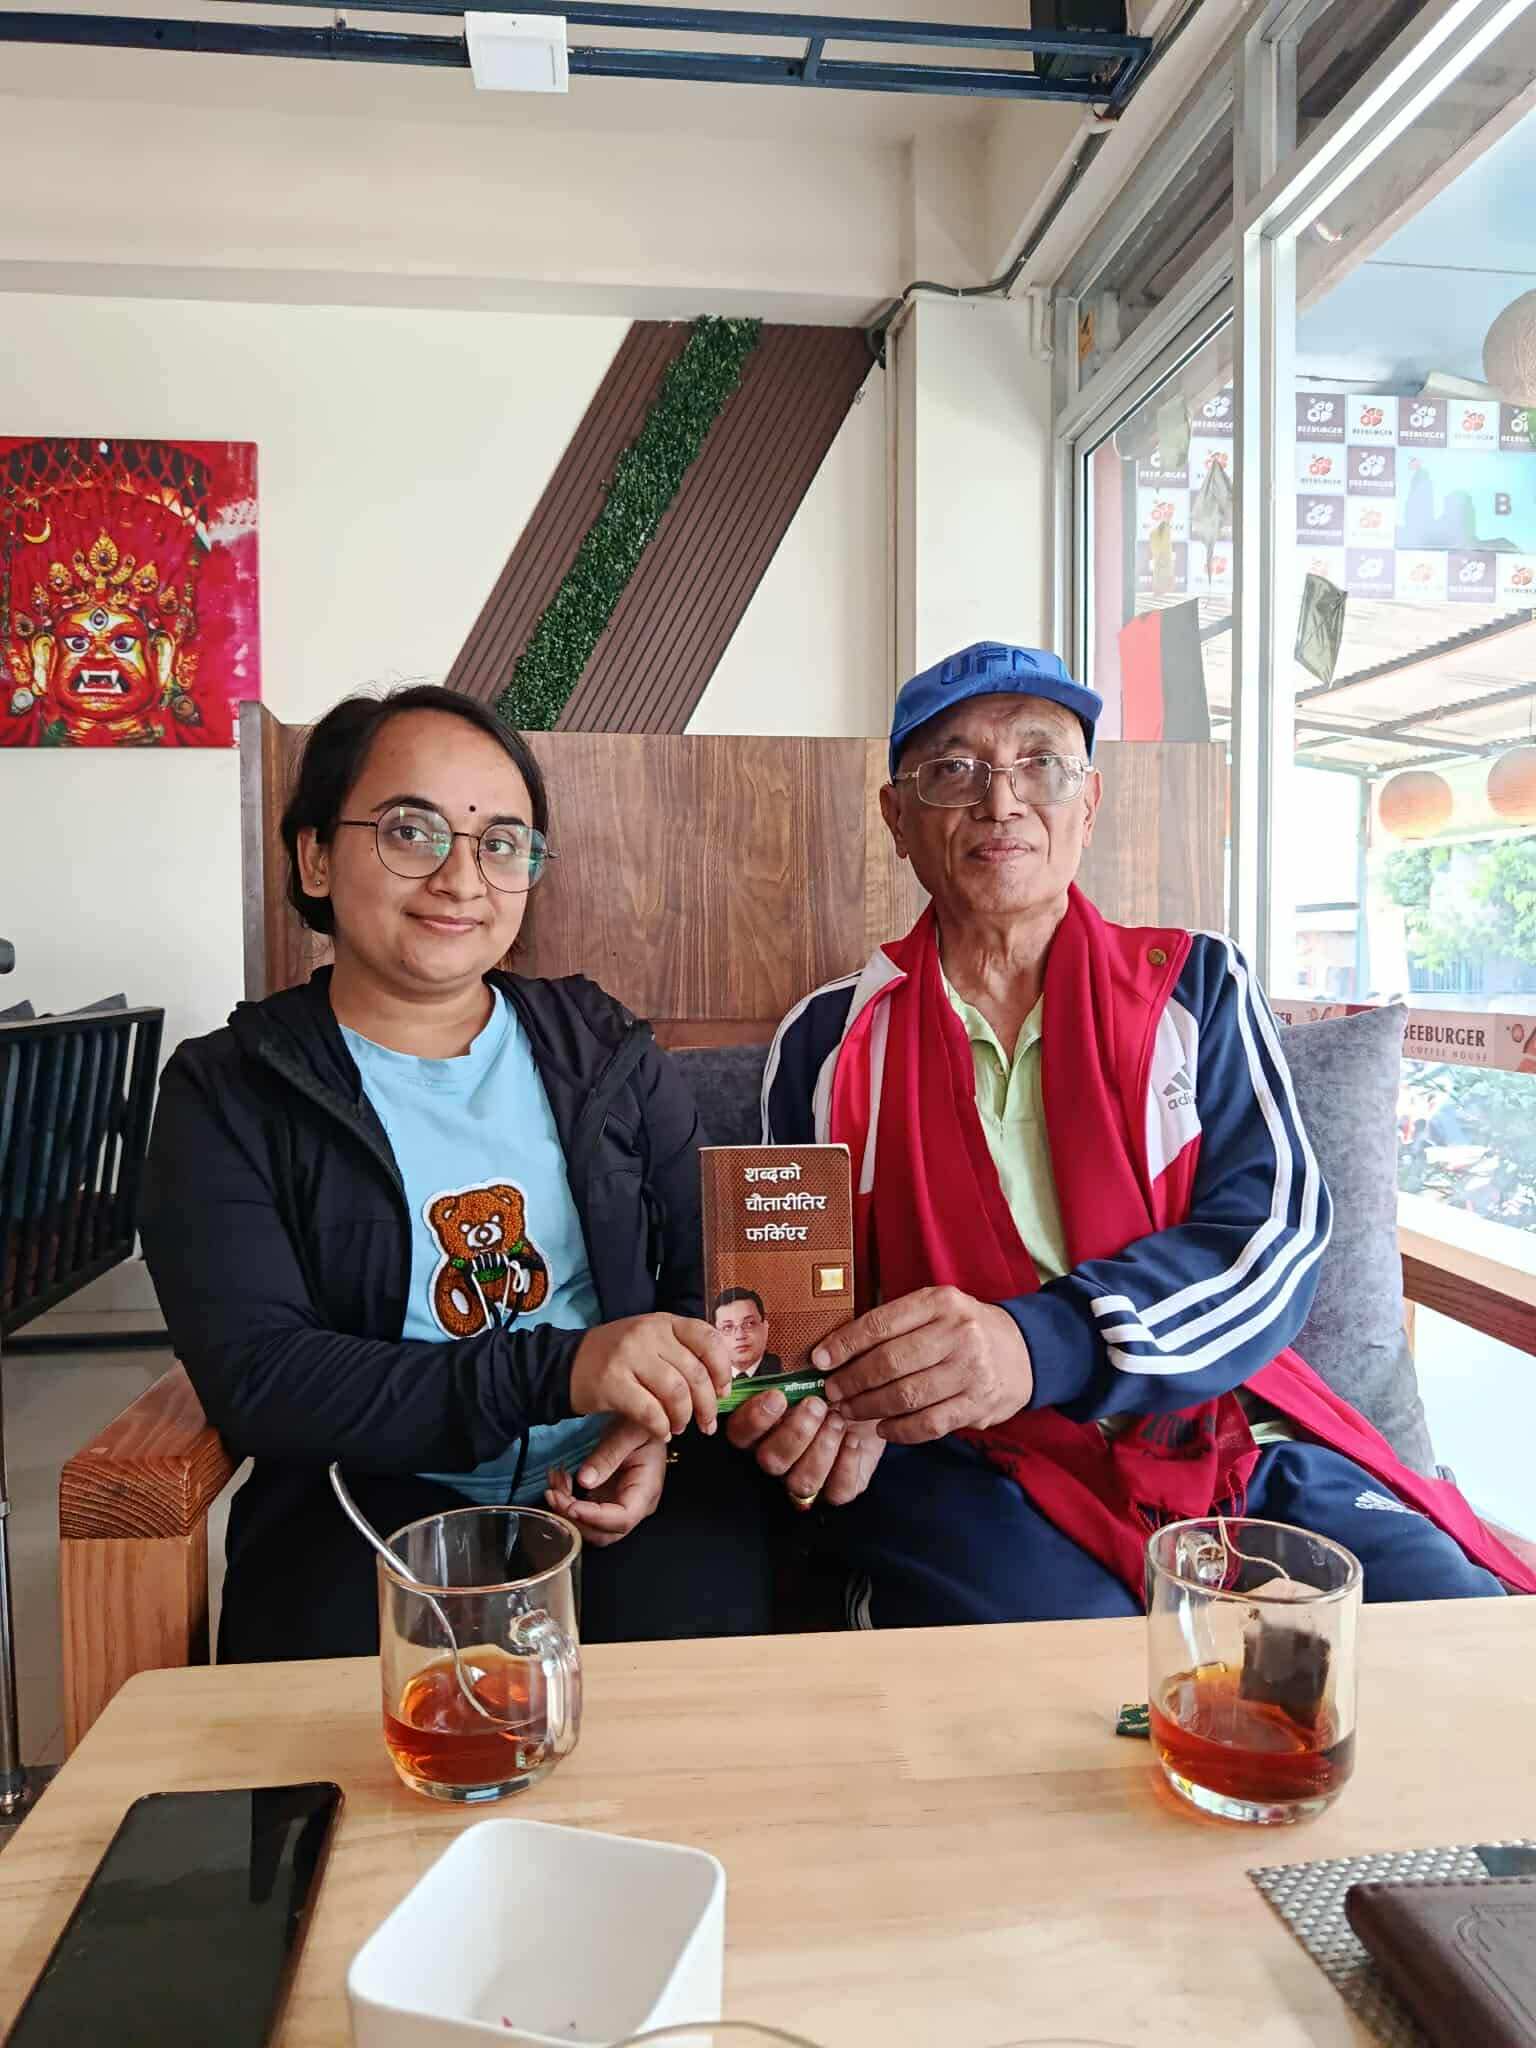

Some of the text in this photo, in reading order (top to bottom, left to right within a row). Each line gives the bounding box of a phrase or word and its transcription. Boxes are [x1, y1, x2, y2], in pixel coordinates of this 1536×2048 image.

[1495, 493, 1511, 516] B
[744, 1162, 802, 1183] शब्दको
[745, 1192, 827, 1211] चौतारीतिर
[745, 1223, 808, 1241] फर्किएर
